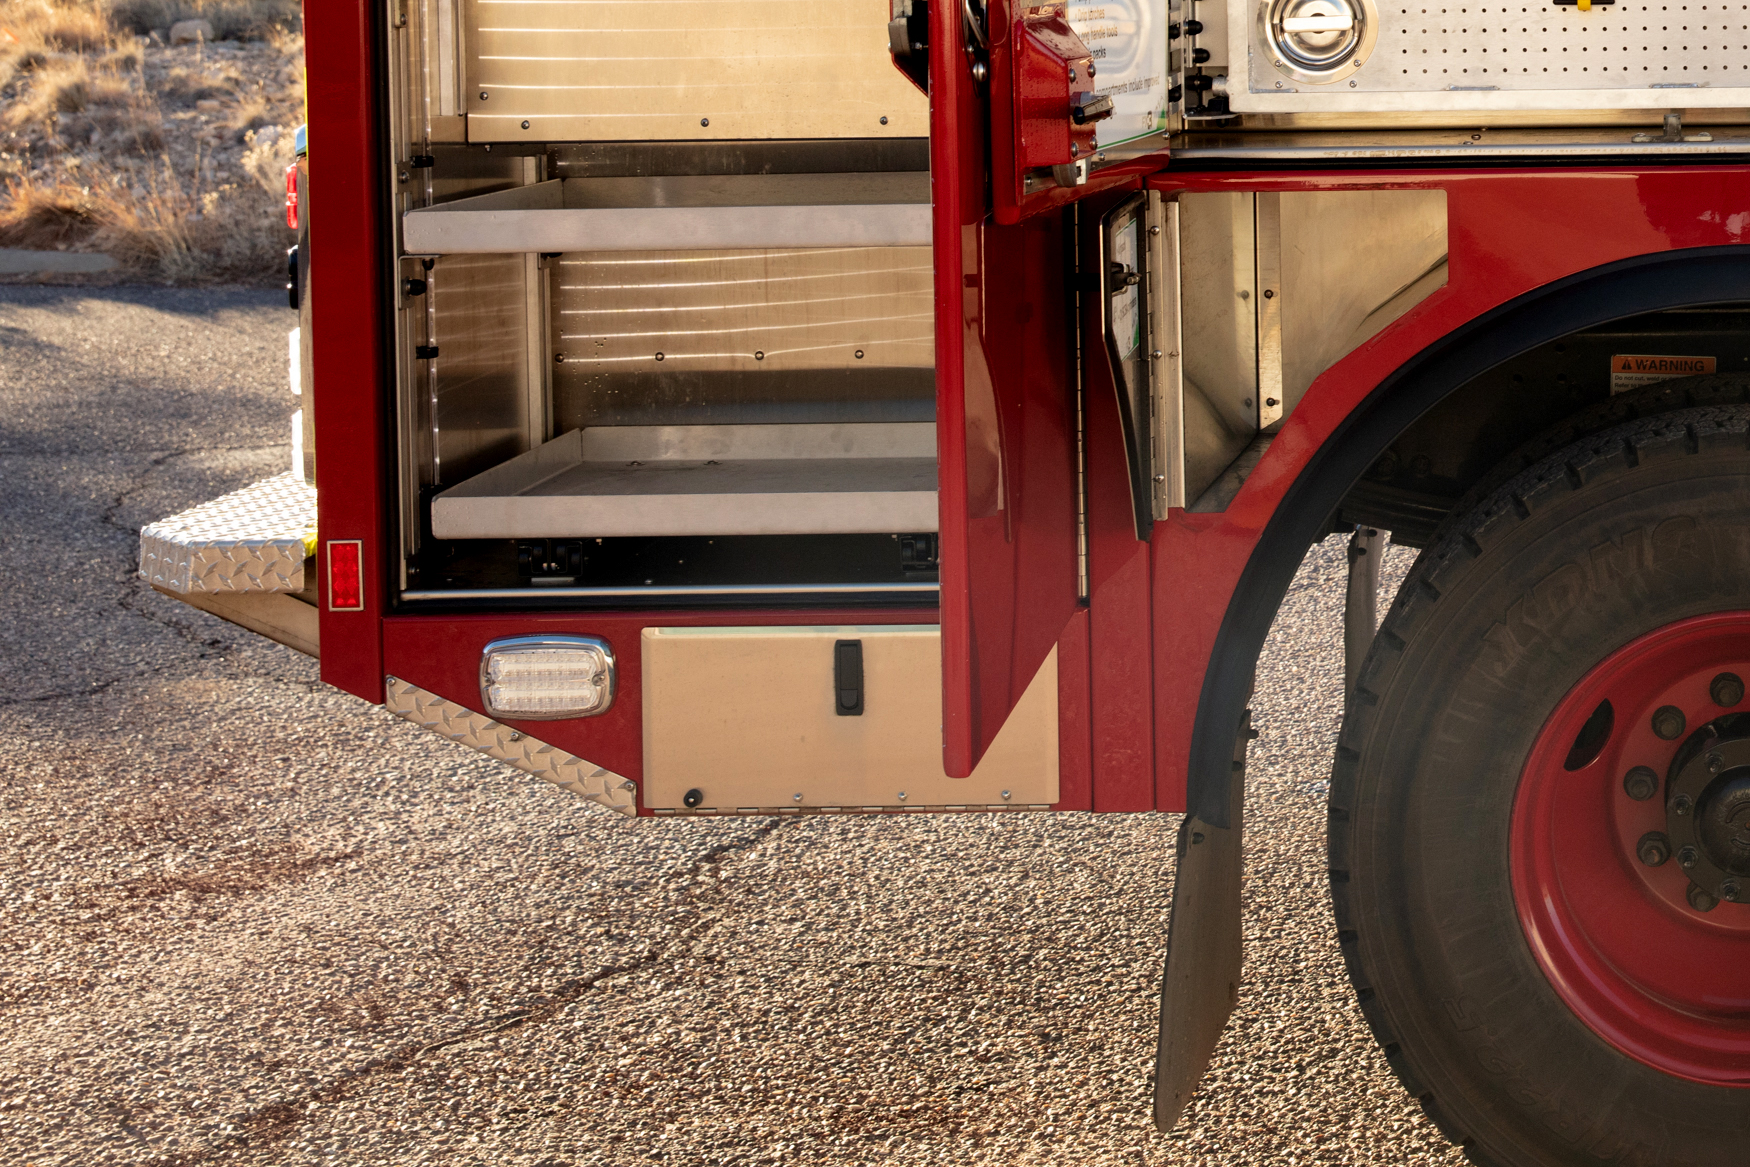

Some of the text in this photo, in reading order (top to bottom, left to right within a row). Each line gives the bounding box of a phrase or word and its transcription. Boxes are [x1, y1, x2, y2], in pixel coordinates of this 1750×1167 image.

[1091, 25, 1106, 41] handle
[1106, 24, 1118, 37] tools
[1128, 77, 1143, 93] include
[1143, 72, 1160, 91] improved
[1635, 359, 1705, 372] WARNING
